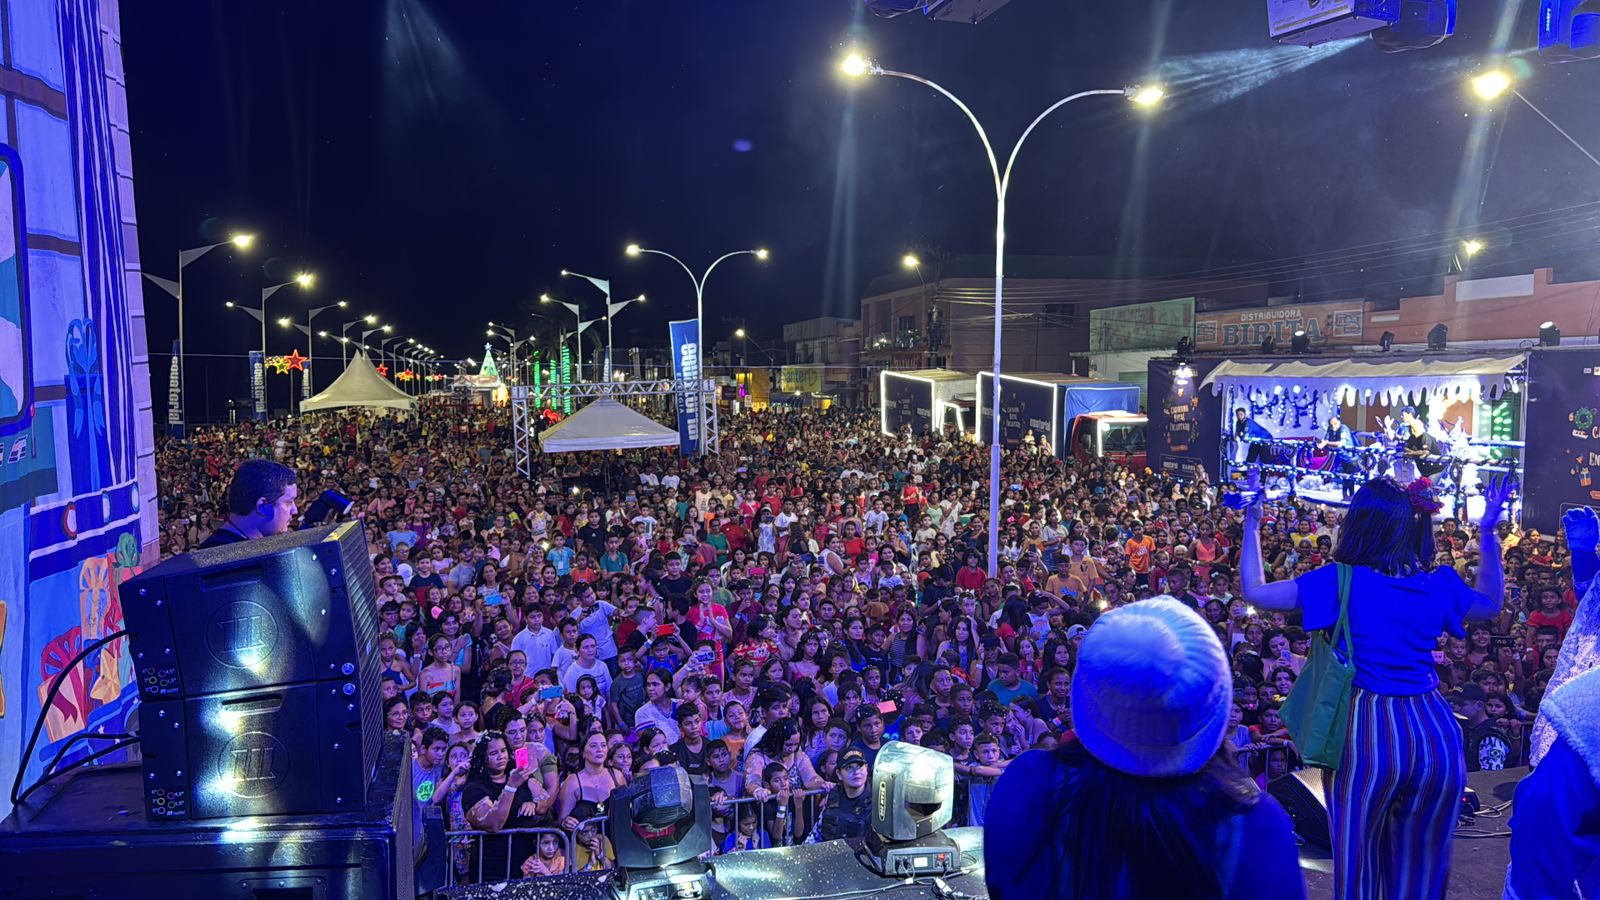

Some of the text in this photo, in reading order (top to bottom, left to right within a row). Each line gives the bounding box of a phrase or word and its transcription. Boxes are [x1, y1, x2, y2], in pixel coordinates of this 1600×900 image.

[1222, 317, 1327, 347] BIRITA
[1240, 309, 1302, 322] DISTRIBUIDORA
[168, 356, 183, 425] equatorial
[254, 362, 266, 413] equatorial
